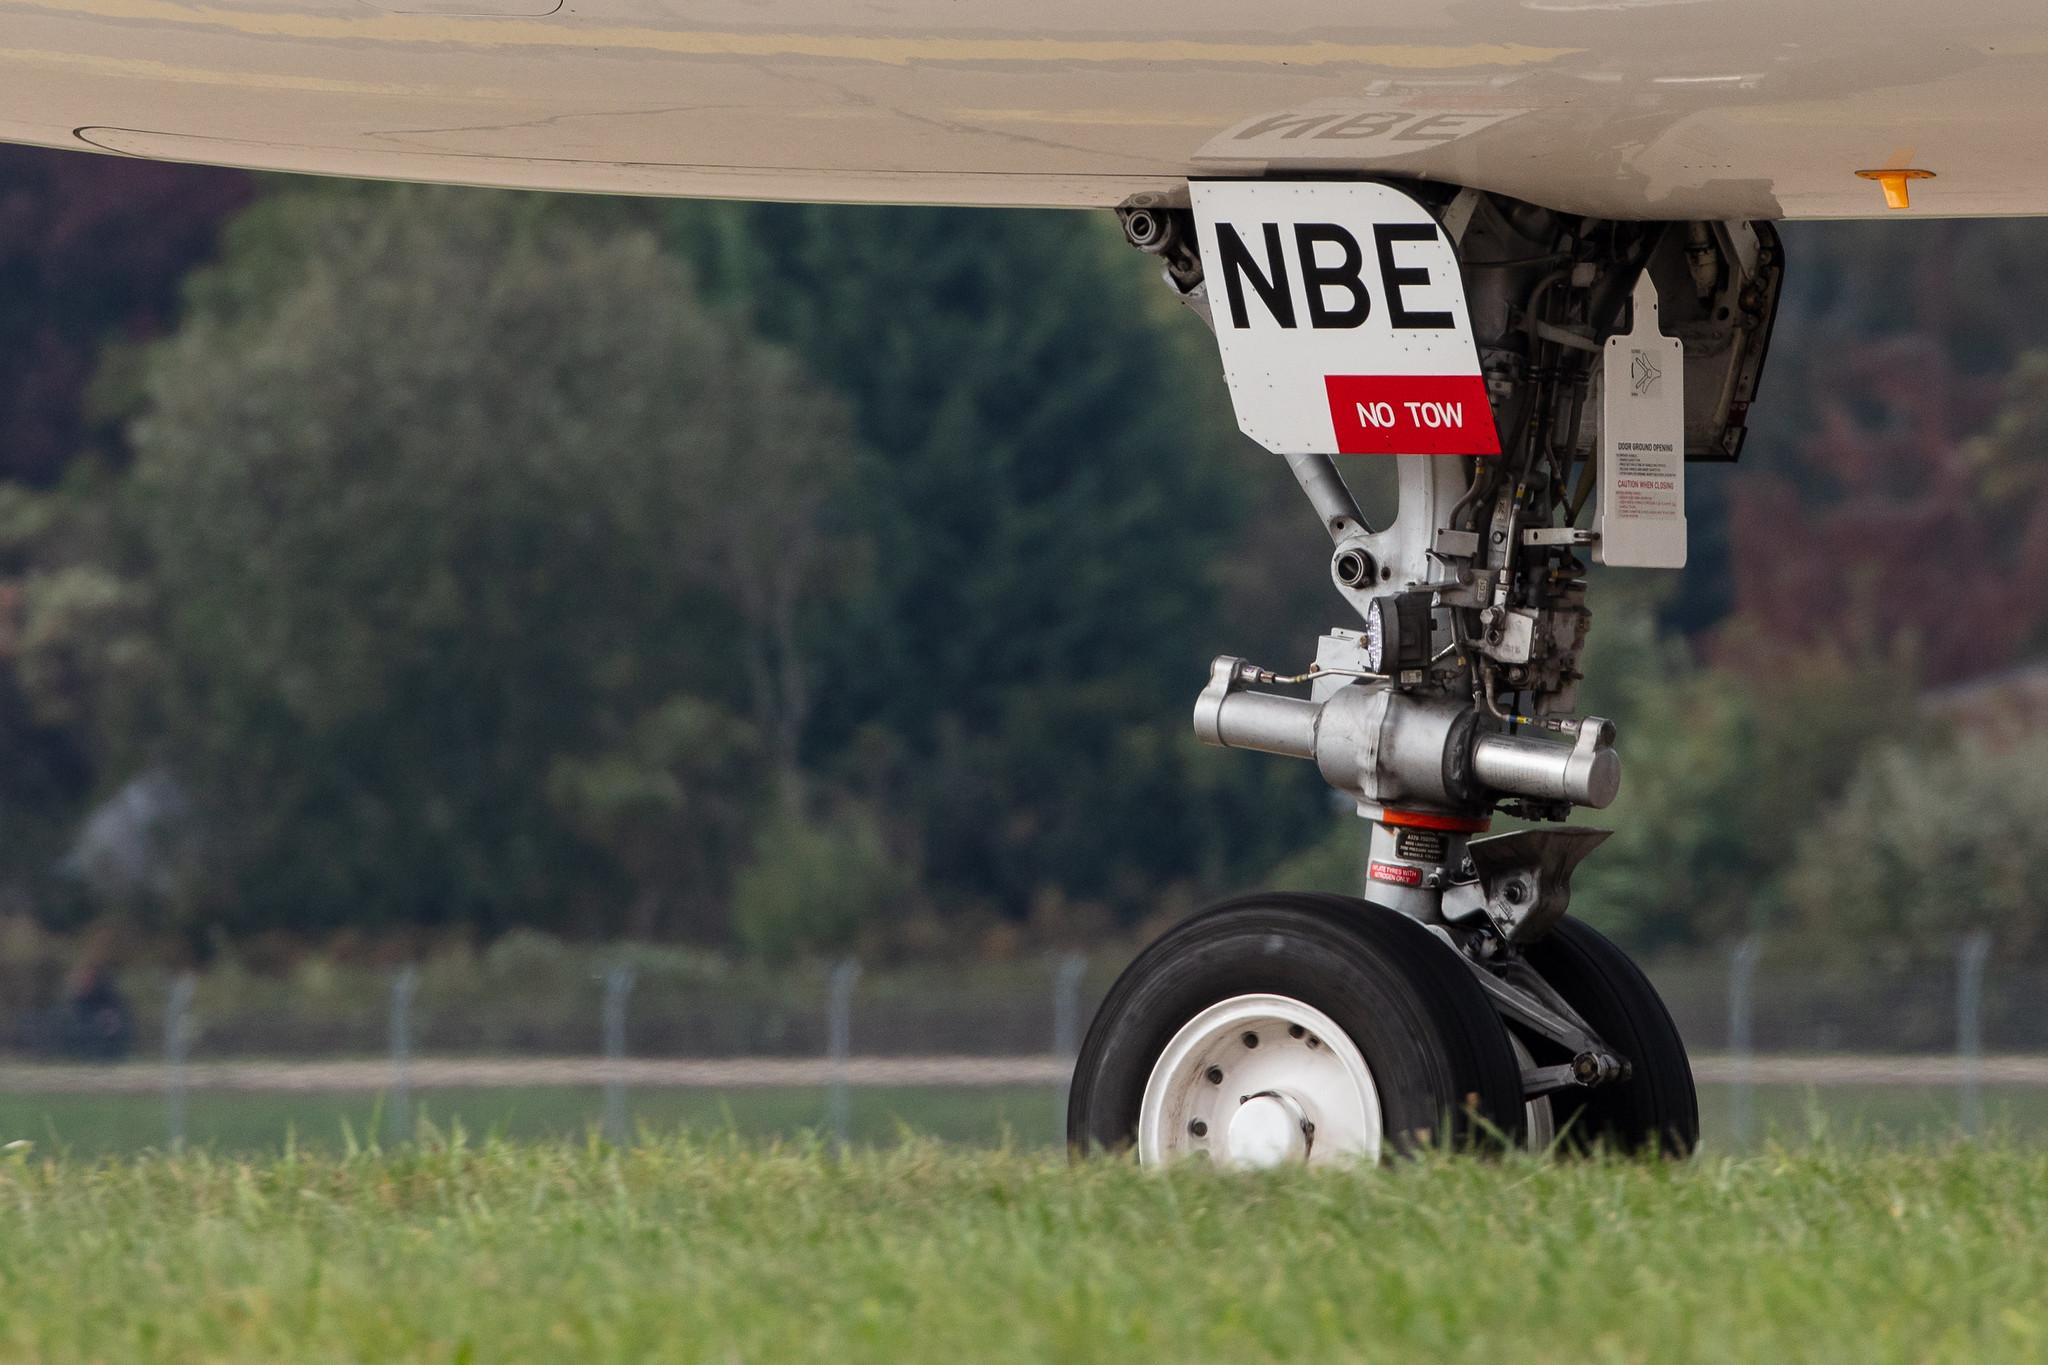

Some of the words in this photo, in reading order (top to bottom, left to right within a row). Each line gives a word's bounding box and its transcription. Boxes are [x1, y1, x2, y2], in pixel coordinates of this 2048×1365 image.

[1213, 222, 1457, 330] NBE
[1356, 402, 1396, 429] NO
[1403, 402, 1464, 429] TOW
[1632, 443, 1652, 451] GROUND
[1653, 444, 1673, 452] OPENING
[1617, 480, 1639, 488] CAUTION
[1654, 482, 1674, 490] CLOSING
[1386, 866, 1402, 875] TYRES
[1402, 869, 1417, 877] WITH
